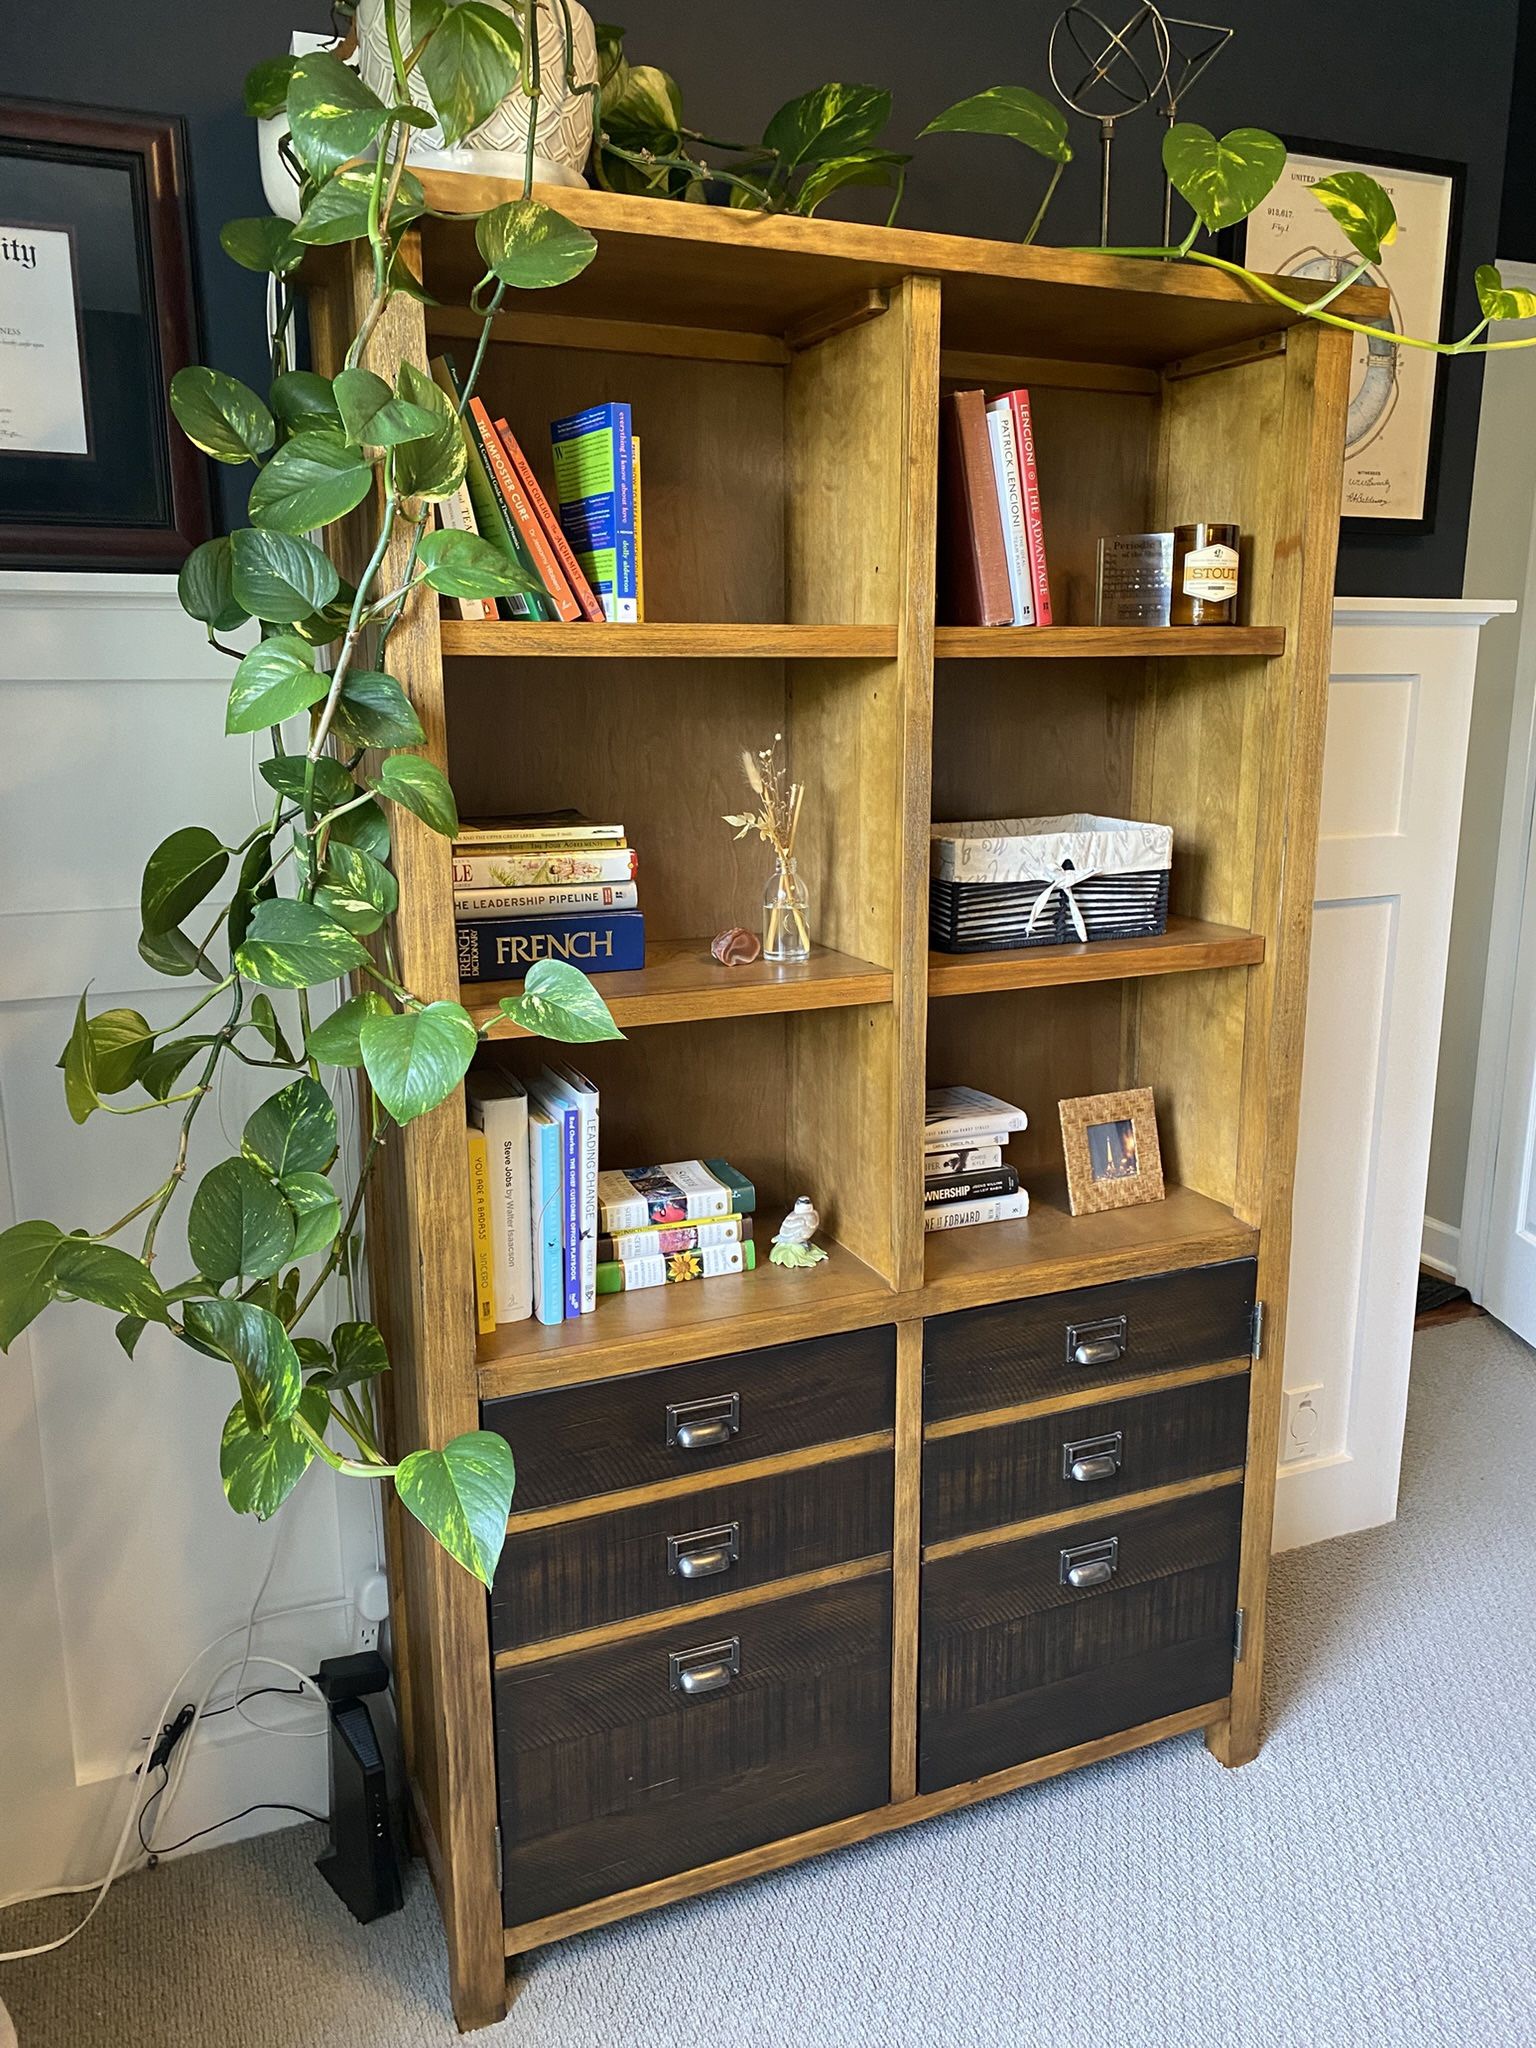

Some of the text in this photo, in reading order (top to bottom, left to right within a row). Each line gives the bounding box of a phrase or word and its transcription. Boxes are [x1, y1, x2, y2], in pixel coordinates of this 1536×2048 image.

[1291, 173, 1316, 183] UNITED
[619, 411, 627, 452] everything
[477, 419, 530, 522] THE IMPOSTER CURE
[1001, 419, 1020, 527] PATRICK LENCIONI
[518, 461, 551, 519] PAULO COELHO
[1020, 404, 1048, 595] LENCIONI THE ADVANTAGE
[492, 477, 501, 497] Guide
[501, 504, 520, 550] Thermodynamics
[621, 507, 629, 523] love
[528, 528, 536, 539] Dr
[1192, 567, 1236, 579] STOUT
[453, 864, 473, 882] LE
[473, 896, 545, 909] LEADERSHIP
[549, 892, 599, 904] PIPELINE
[458, 928, 471, 977] FRENCH
[470, 928, 480, 976] DICTIONARY
[495, 930, 613, 965] FRENCH
[474, 1157, 483, 1176] YOU
[585, 1119, 596, 1220] LEADING CHANGE
[476, 1178, 484, 1195] ARE
[924, 1185, 970, 1202] WNERSHIP
[503, 1141, 515, 1268] Steve Jobs by Walter Isaacson
[944, 1210, 981, 1228] FORWARD
[477, 1206, 487, 1240] BADASS
[479, 1252, 489, 1289] SINCERO
